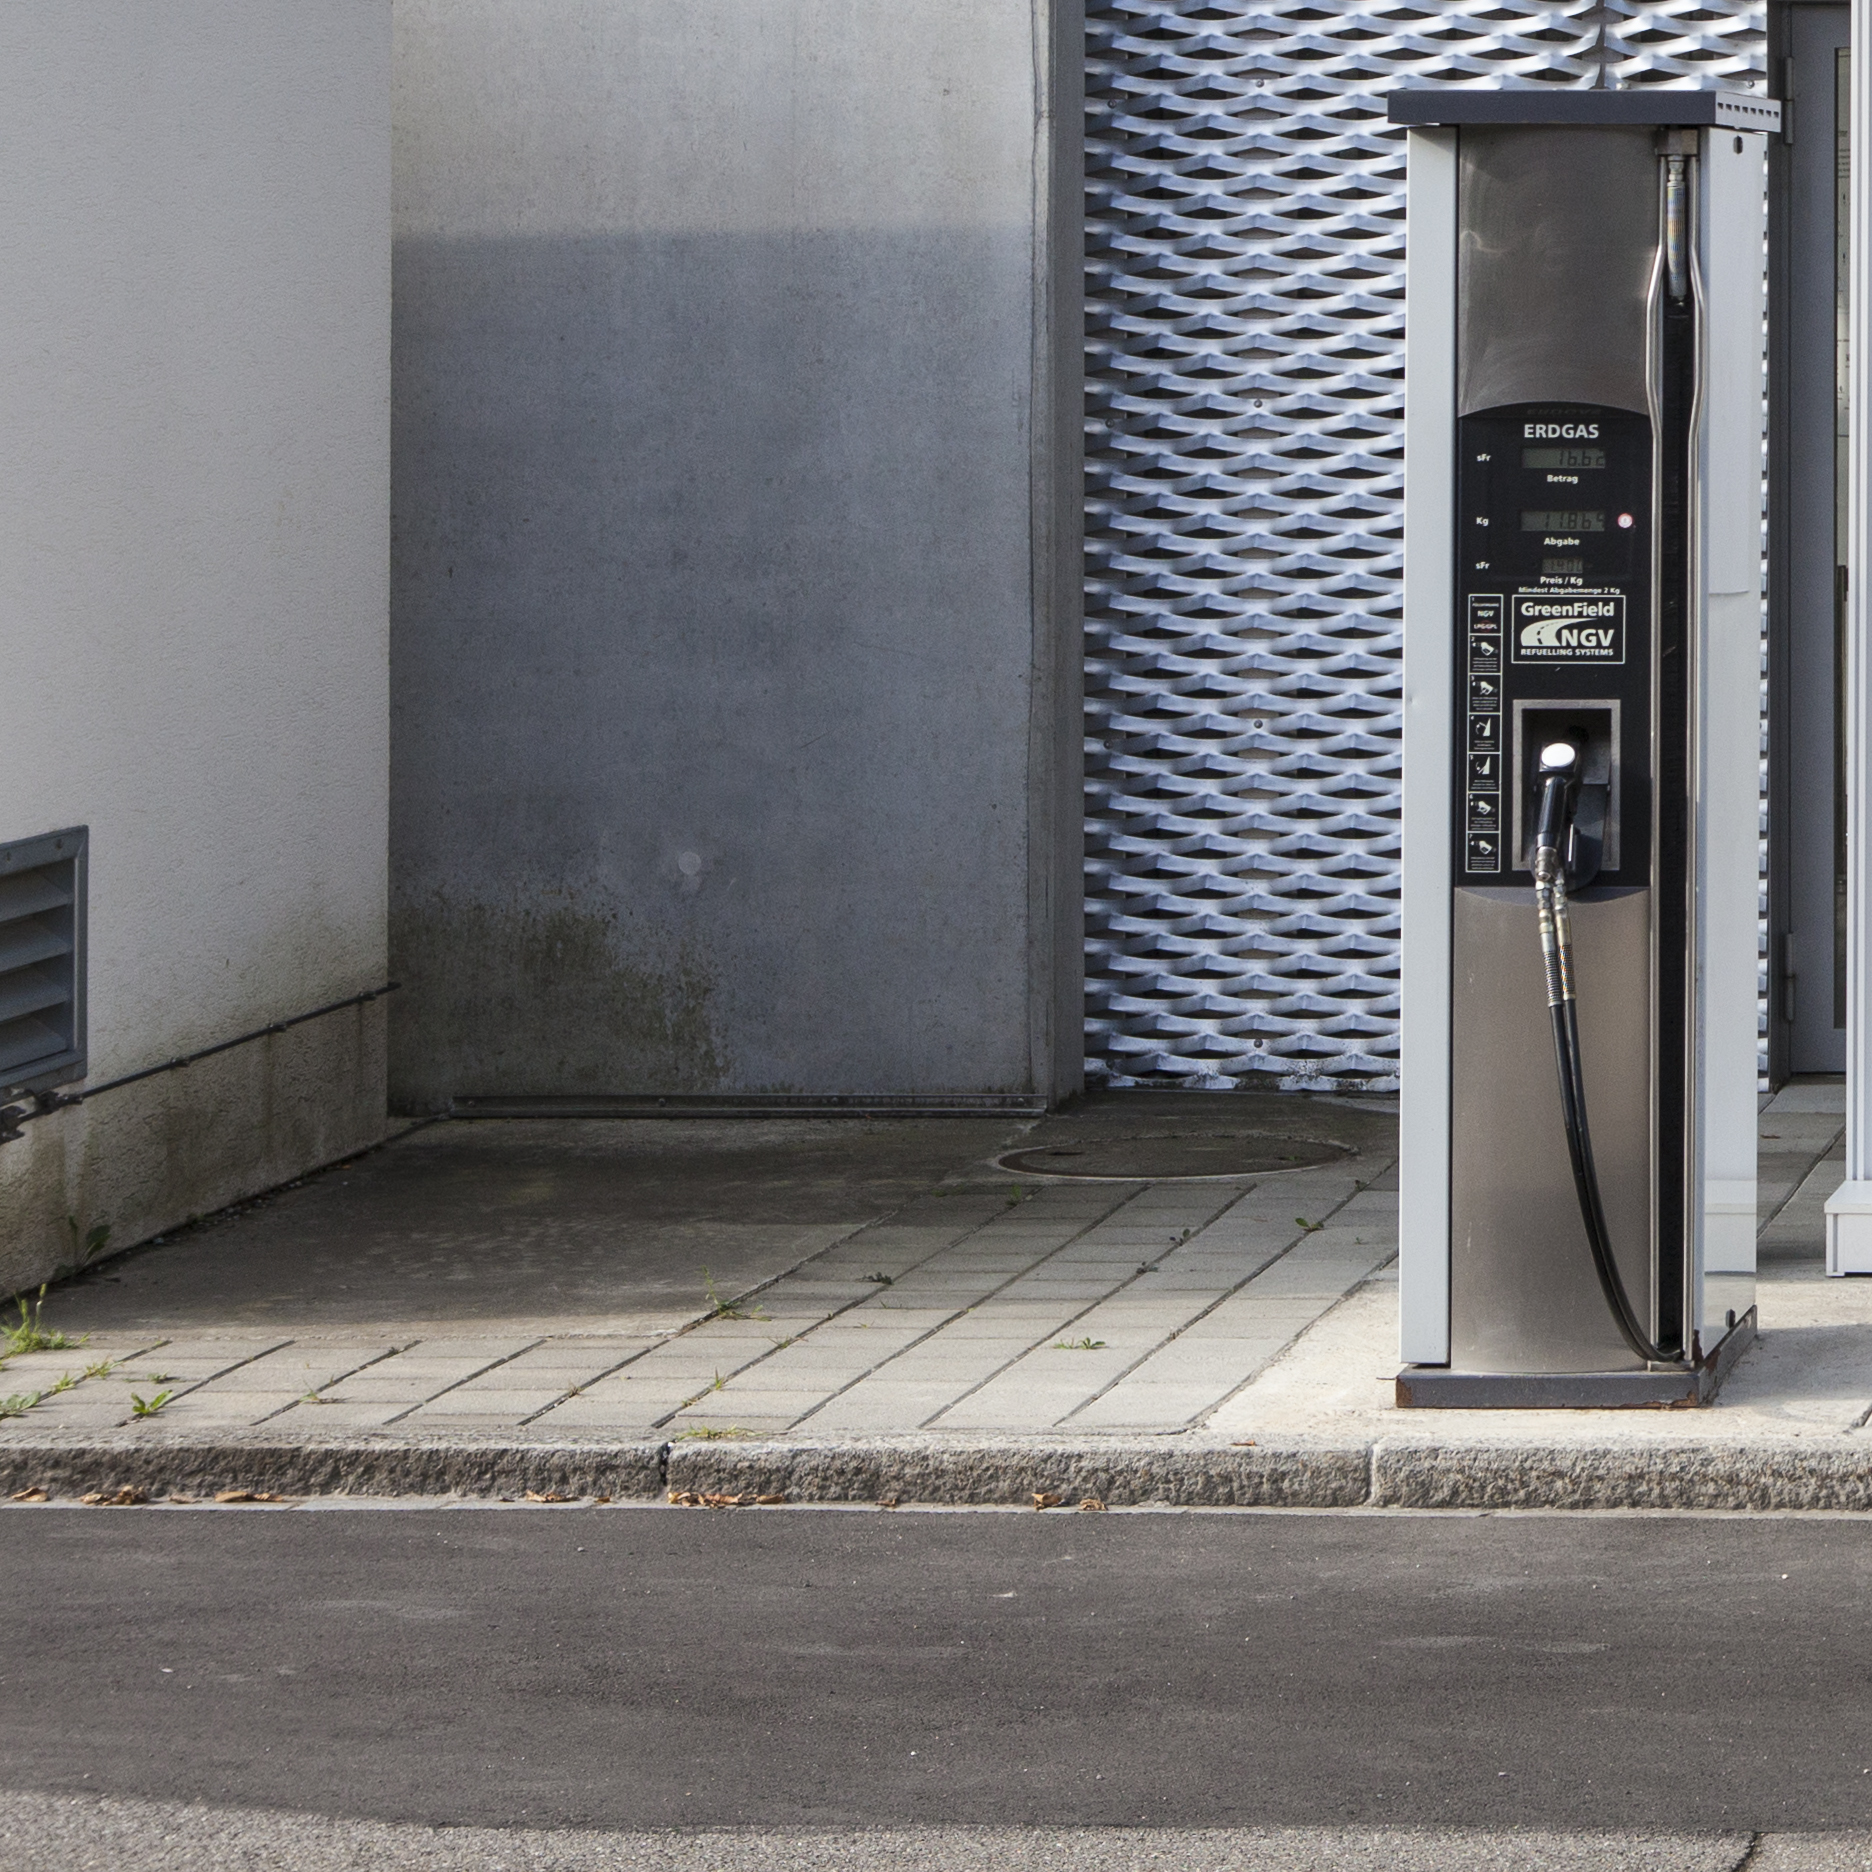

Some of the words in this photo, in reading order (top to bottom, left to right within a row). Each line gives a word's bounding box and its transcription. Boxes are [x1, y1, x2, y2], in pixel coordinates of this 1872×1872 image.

[1523, 424, 1599, 439] ERDGAS
[1476, 454, 1492, 462] sFr
[1547, 474, 1579, 484] Betrag
[1476, 517, 1489, 526] Kg
[1544, 537, 1580, 547] Abgabe
[1475, 562, 1490, 570] sFr
[1540, 576, 1563, 584] Preis
[1570, 576, 1583, 586] Kg
[1610, 587, 1620, 595] Kg
[1521, 602, 1615, 617] GreenField
[1561, 629, 1615, 647] NGV
[1520, 648, 1573, 656] REFUELLING
[1575, 648, 1614, 656] SYSTEMS
